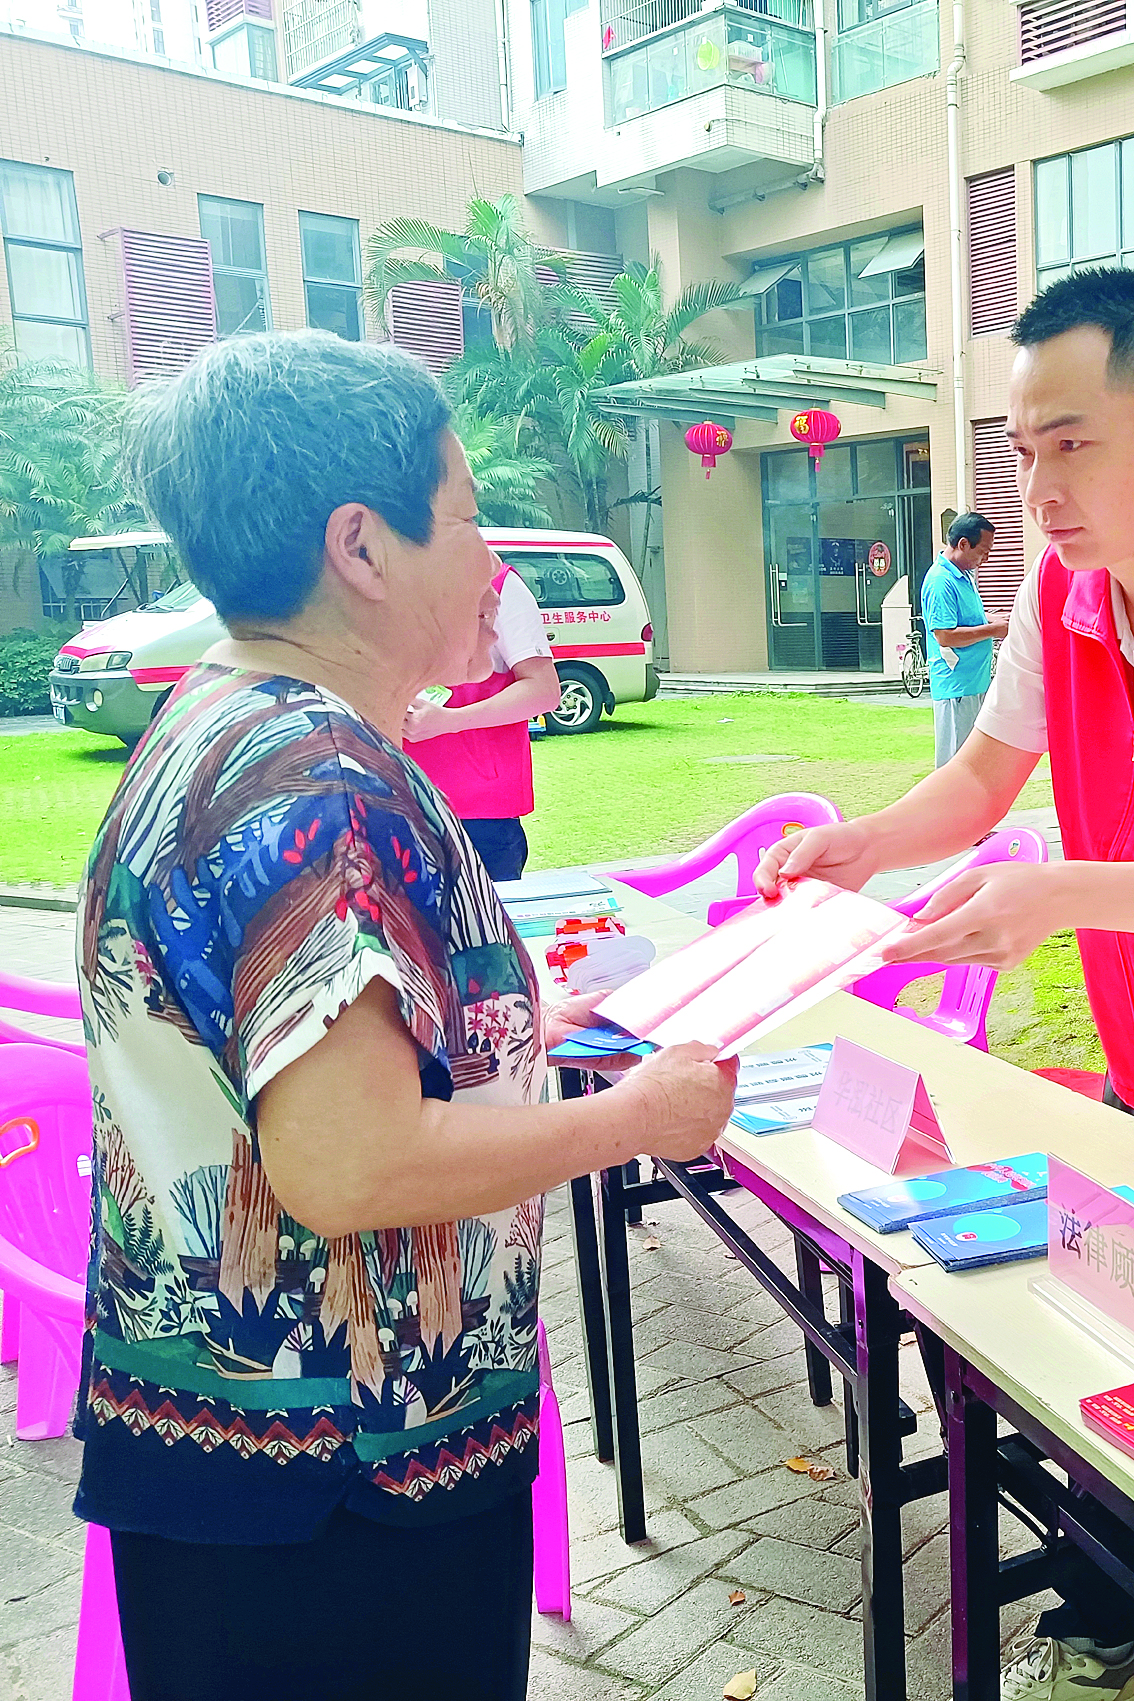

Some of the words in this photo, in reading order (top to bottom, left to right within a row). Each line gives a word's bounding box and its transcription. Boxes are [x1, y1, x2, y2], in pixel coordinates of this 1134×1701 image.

[540, 610, 612, 625] 卫生服务中心
